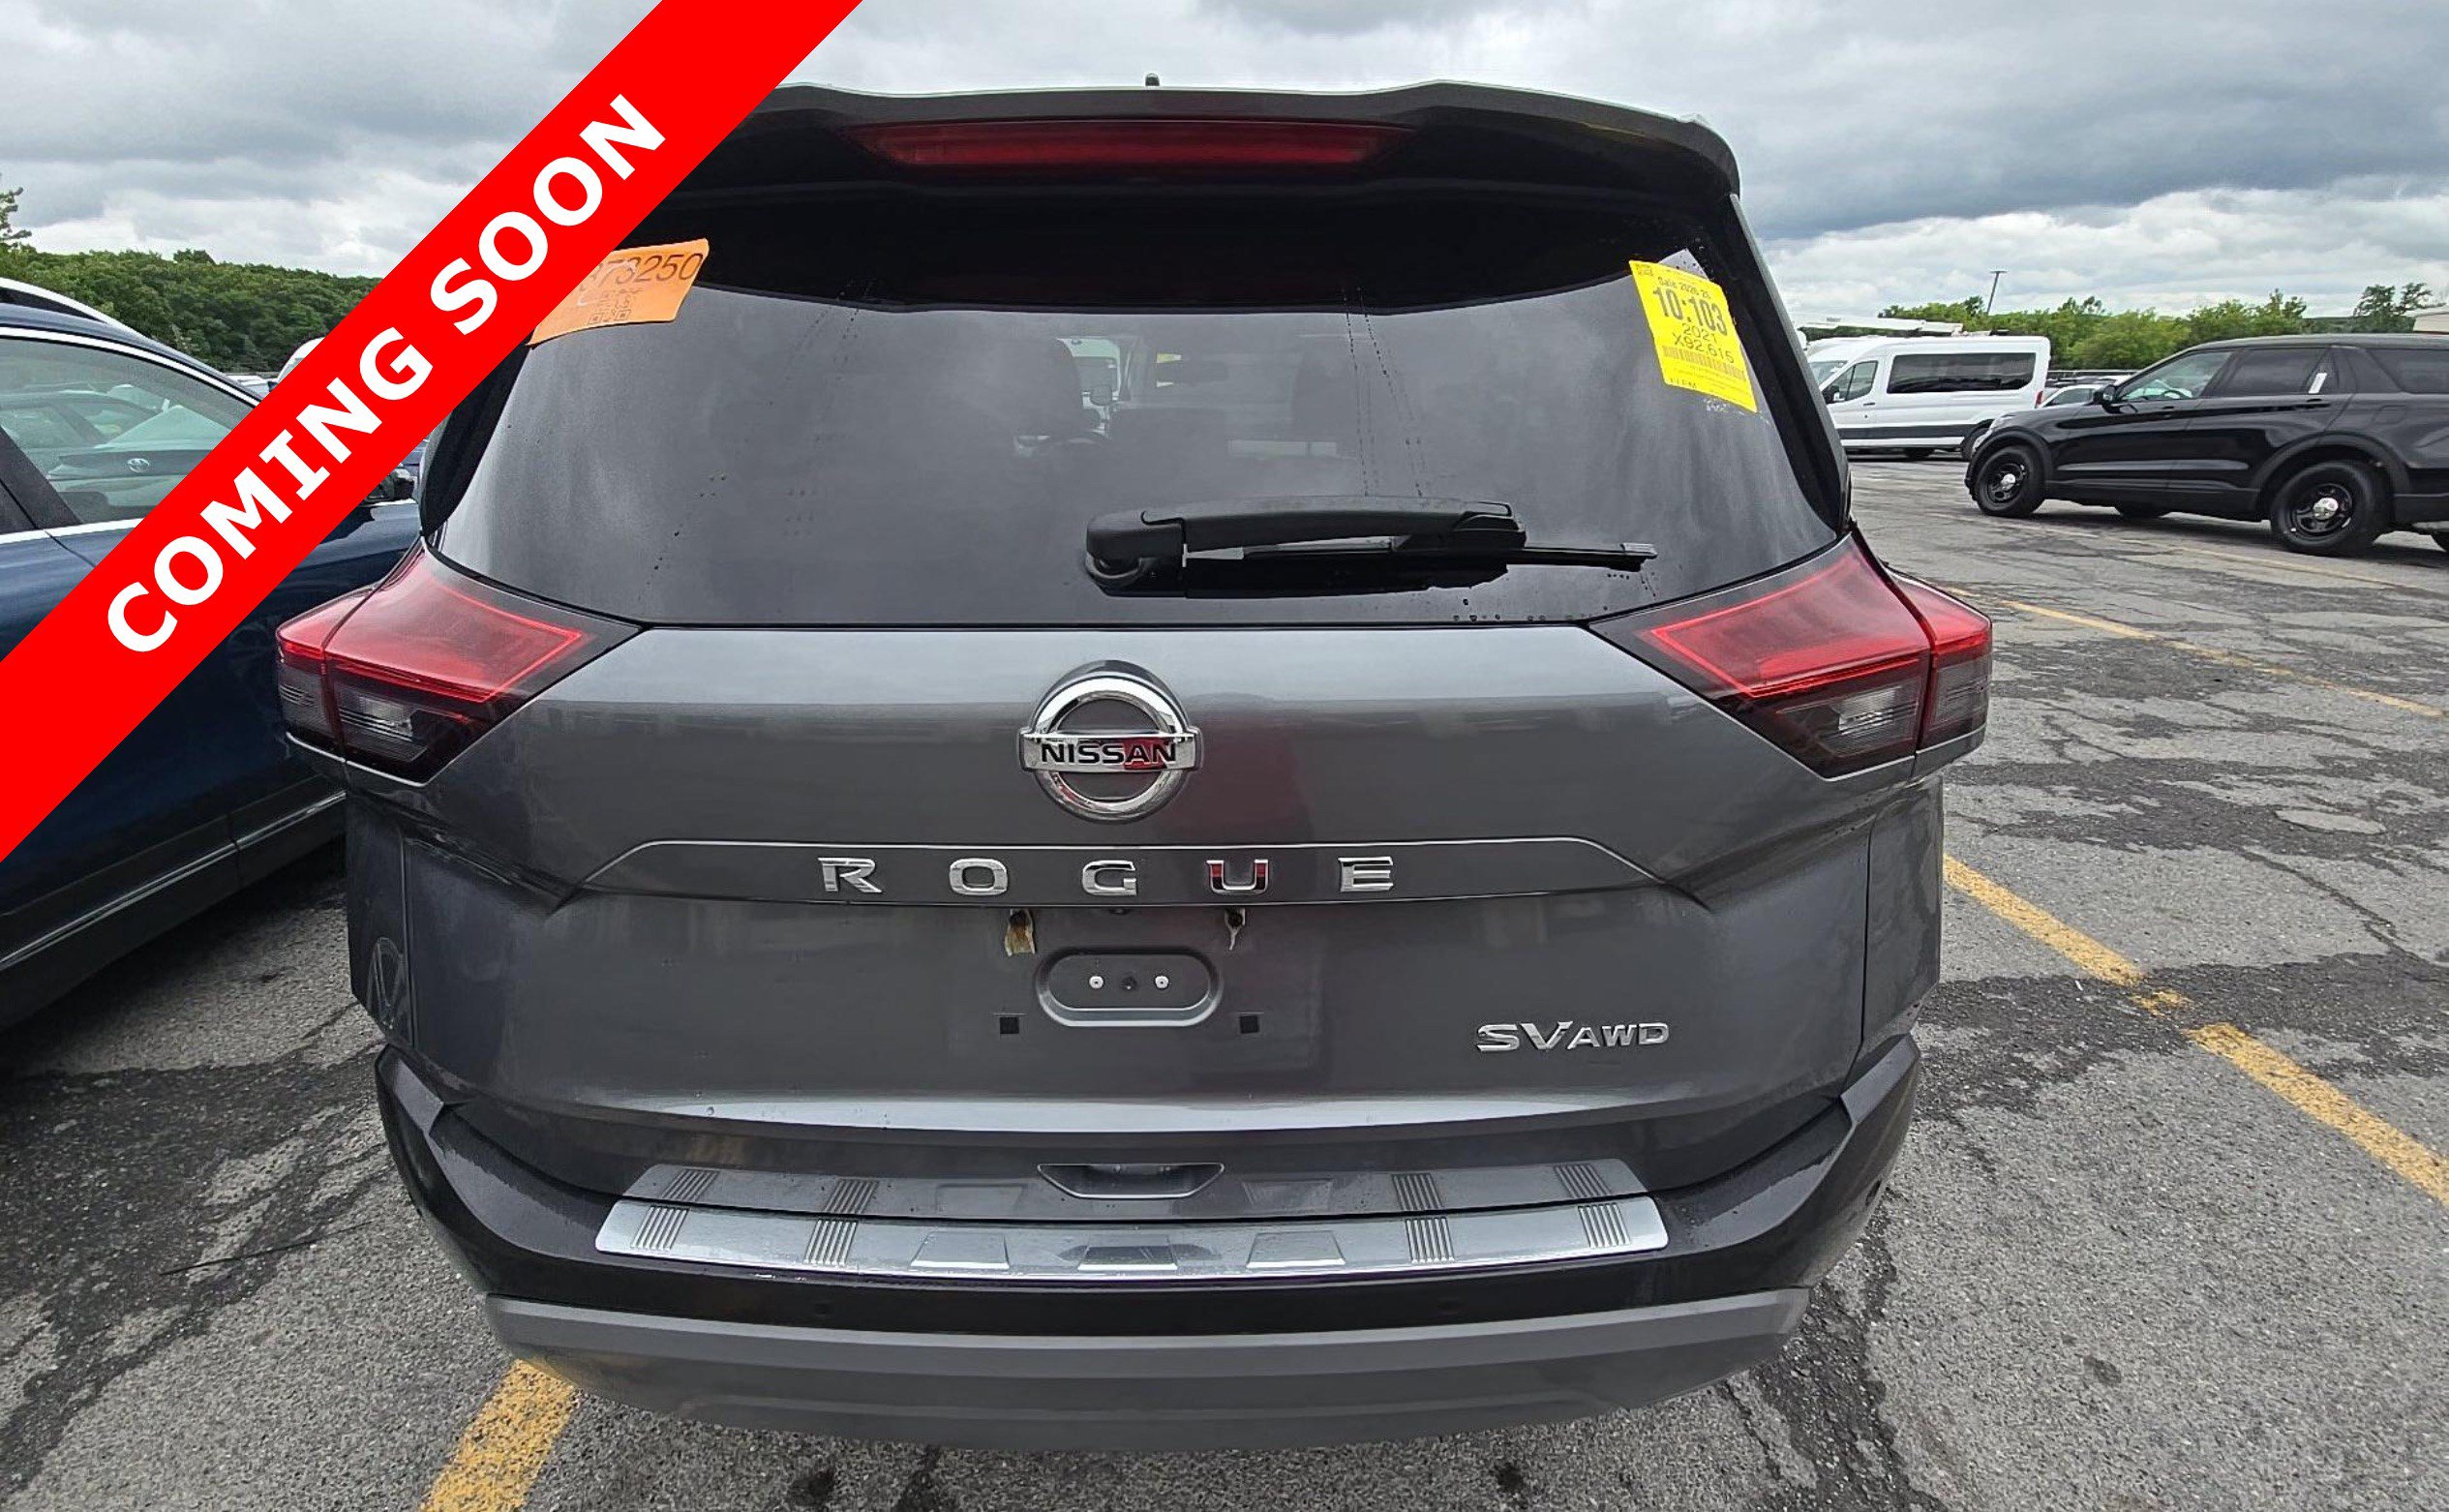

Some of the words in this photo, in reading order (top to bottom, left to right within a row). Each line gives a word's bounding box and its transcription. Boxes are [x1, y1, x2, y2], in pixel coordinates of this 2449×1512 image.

[1681, 322, 1718, 344] 2021
[1041, 742, 1176, 764] NISSAN
[818, 856, 1394, 896] ROGUE
[1567, 1022, 1670, 1050] AWD
